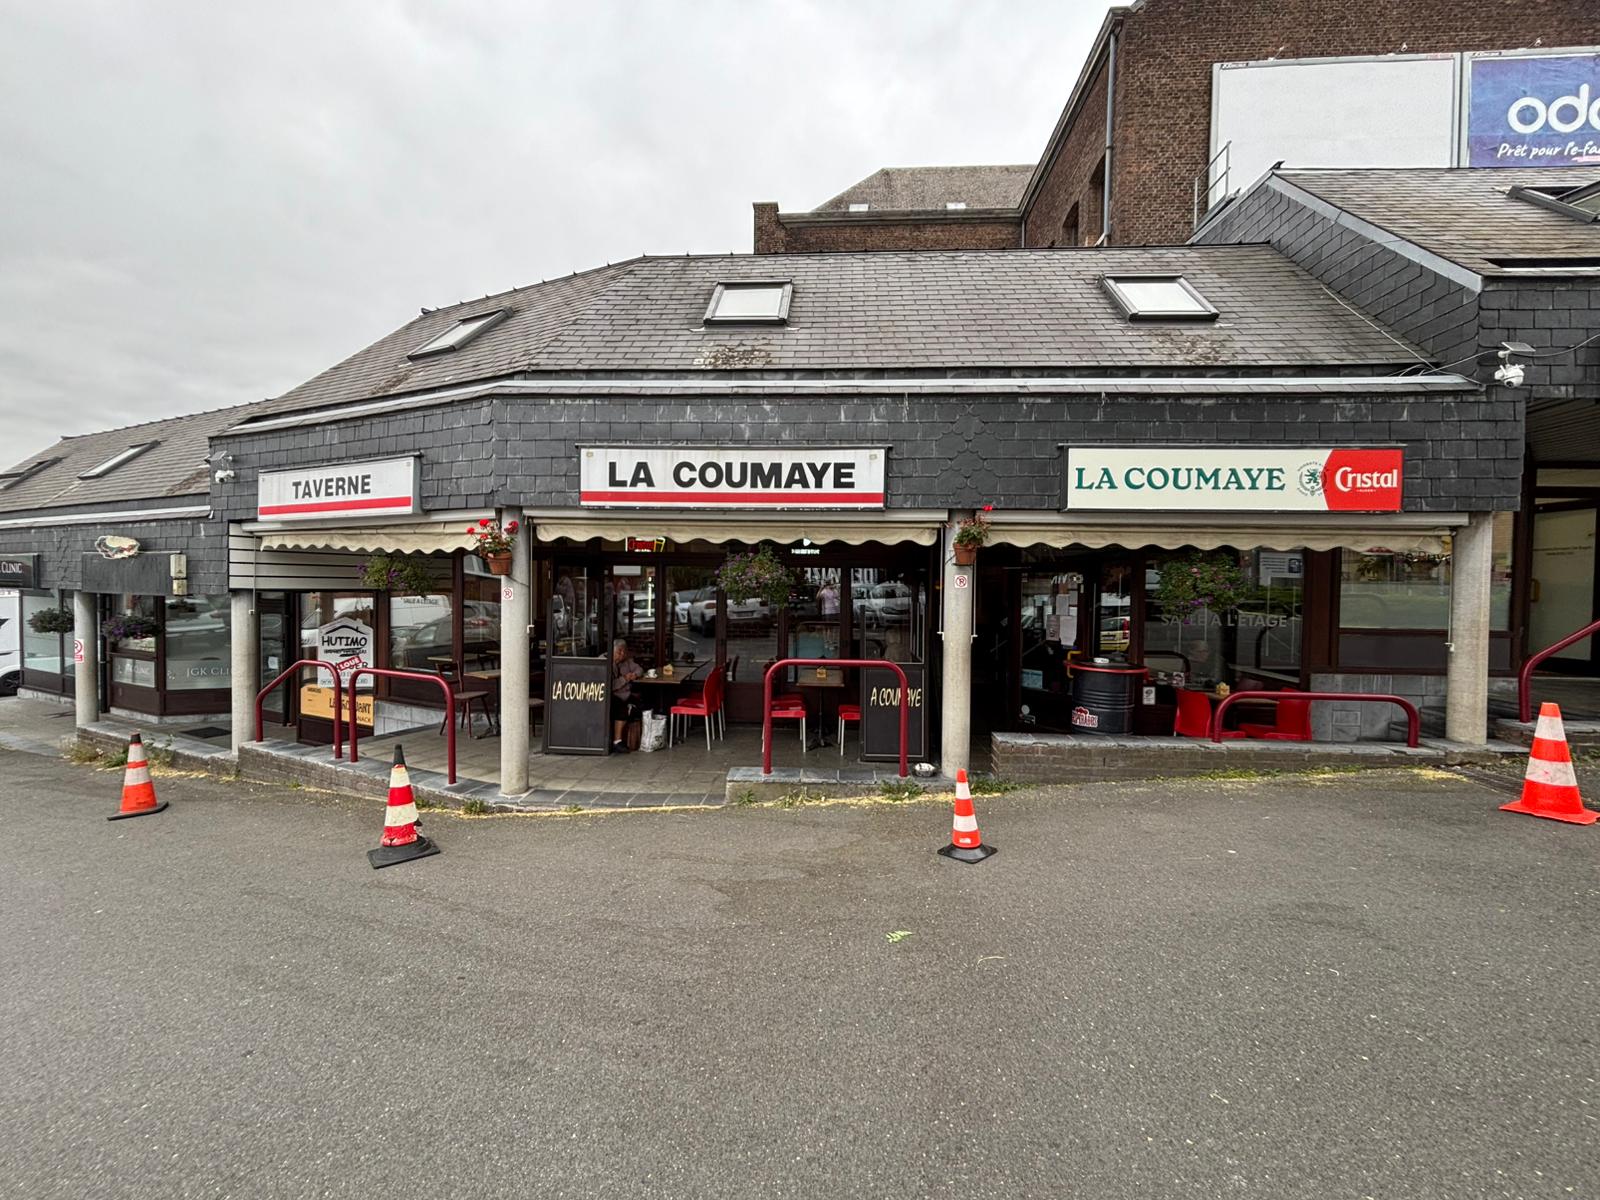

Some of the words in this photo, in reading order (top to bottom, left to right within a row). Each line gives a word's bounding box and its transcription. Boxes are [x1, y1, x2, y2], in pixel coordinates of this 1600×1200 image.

[1497, 143, 1528, 158] Prêt
[1529, 146, 1561, 159] pour
[608, 461, 655, 487] LA
[672, 461, 855, 489] COUMAYE
[1075, 467, 1118, 490] LA
[1124, 467, 1286, 491] COUMAYE
[1335, 466, 1398, 492] Cristal
[292, 474, 372, 499] TAVERNE
[1161, 614, 1207, 626] SALE
[321, 636, 368, 647] HUTIMO
[186, 667, 208, 678] JGK
[552, 680, 562, 700] LA
[563, 681, 605, 702] COUMAYE
[879, 687, 922, 707] COUAYE
